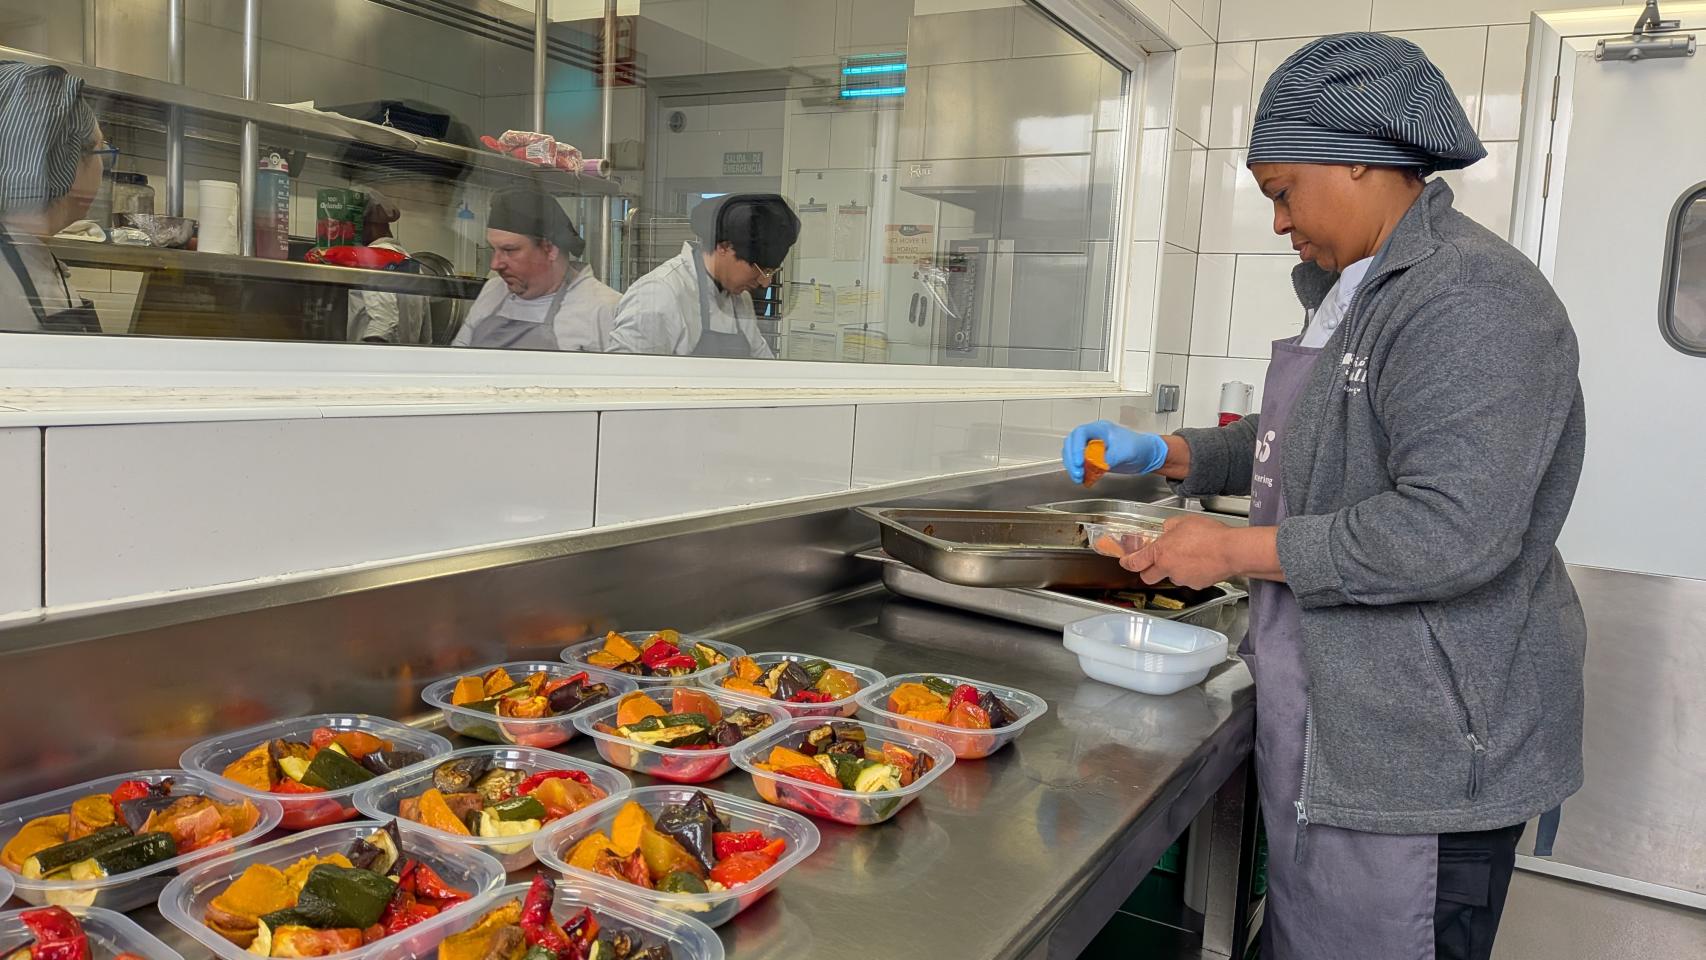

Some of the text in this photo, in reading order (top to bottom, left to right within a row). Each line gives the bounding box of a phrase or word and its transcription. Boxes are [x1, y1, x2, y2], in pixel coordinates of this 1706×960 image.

[725, 153, 762, 163] SALIDA DE
[723, 164, 762, 173] EMERGENCIA
[320, 202, 343, 210] Orlando
[1254, 474, 1273, 488] tering
